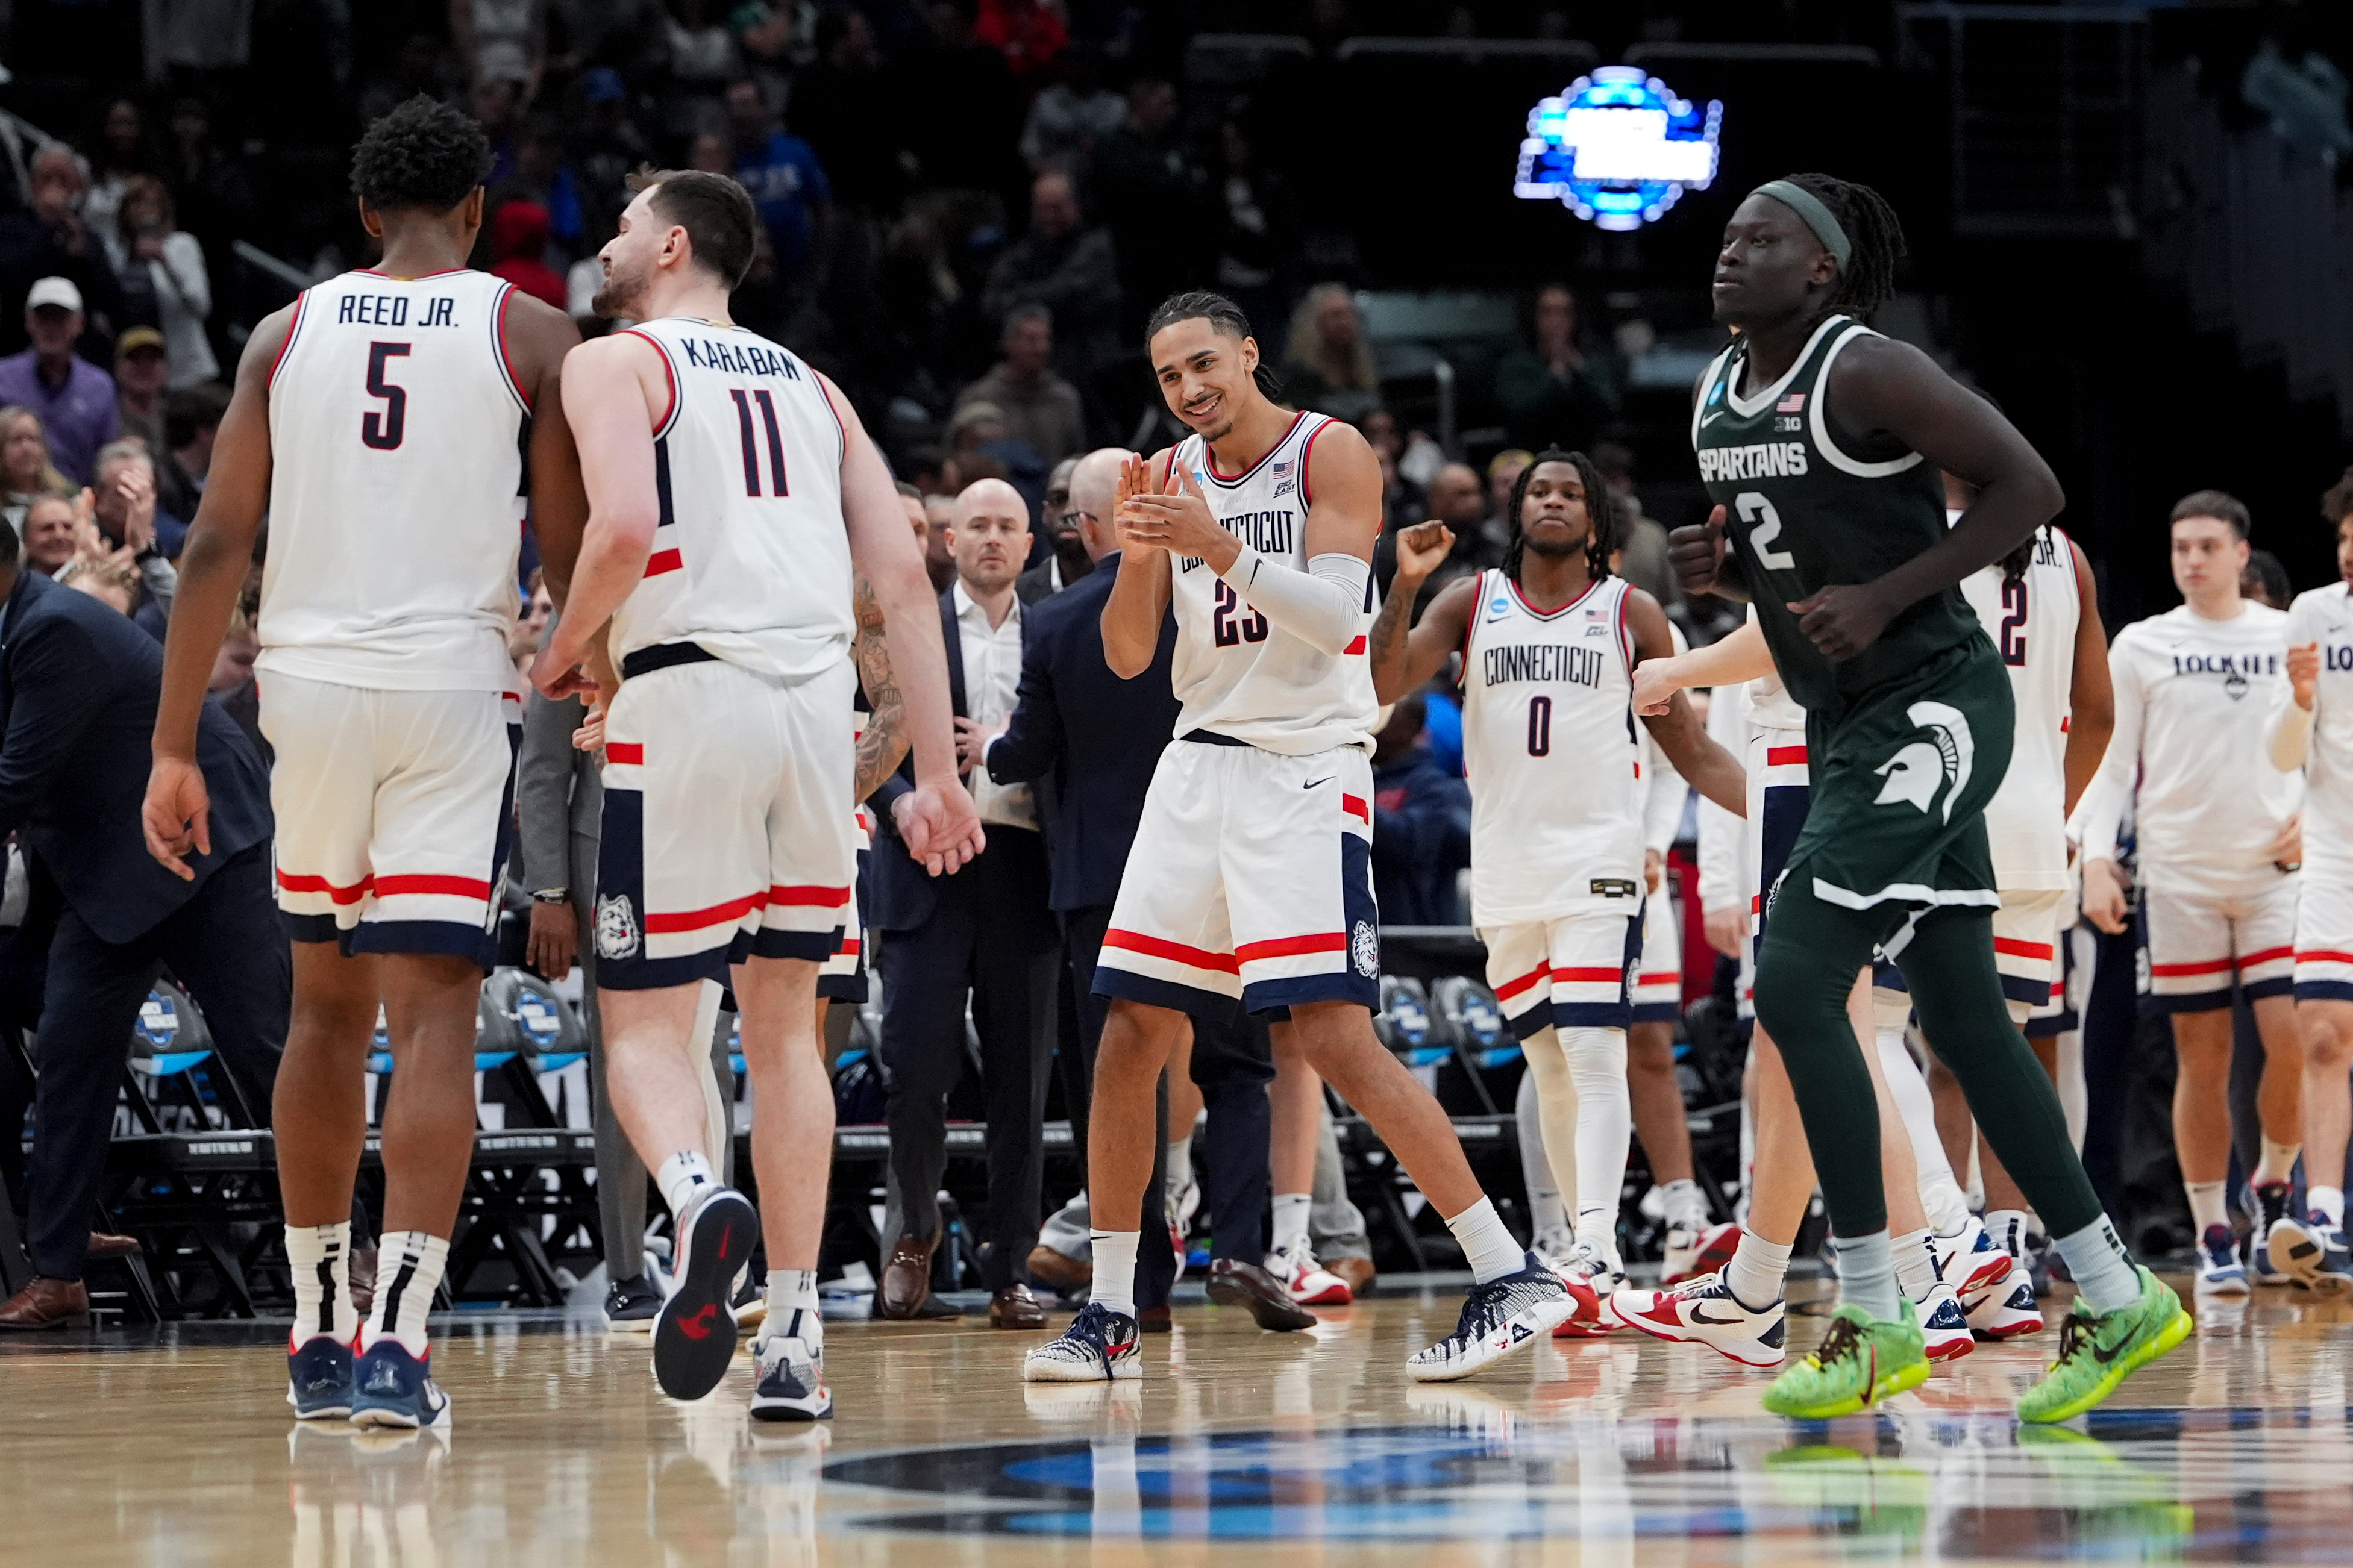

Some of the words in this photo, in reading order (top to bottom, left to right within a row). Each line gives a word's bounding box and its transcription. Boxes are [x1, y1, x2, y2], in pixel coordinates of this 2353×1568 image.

[339, 295, 409, 326] REED
[418, 298, 460, 328] JR.
[680, 338, 801, 381] KARABAN
[362, 340, 412, 451] 5
[729, 389, 789, 497] 11
[1698, 442, 1808, 482] SPARTANS
[1735, 491, 1796, 570] 2
[2036, 539, 2063, 567] JR.
[2001, 575, 2027, 666] 2
[1484, 645, 1605, 689] CONNECTICUT
[1528, 696, 1552, 757] 0
